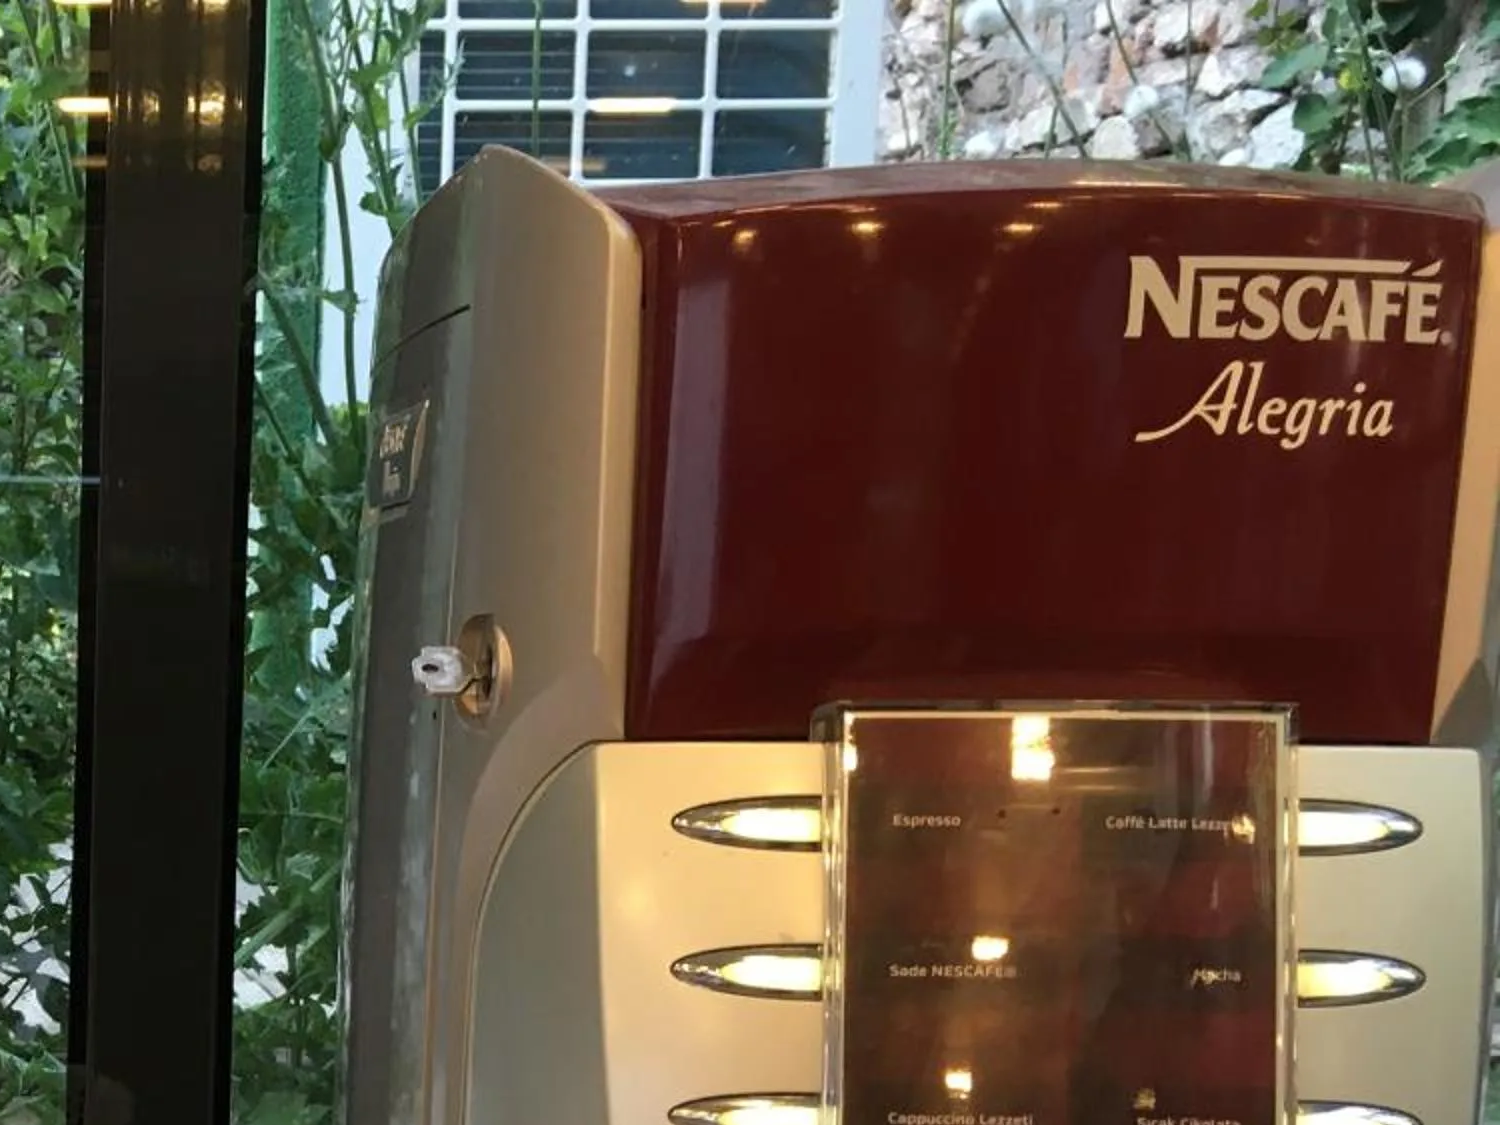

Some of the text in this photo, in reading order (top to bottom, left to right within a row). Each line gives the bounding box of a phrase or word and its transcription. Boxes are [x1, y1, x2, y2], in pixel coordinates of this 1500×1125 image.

[1135, 360, 1393, 450] Alegria
[892, 813, 961, 828] Espresso
[1150, 817, 1187, 829] Latte
[888, 964, 927, 977] Sade
[887, 1112, 974, 1125] Cappuccino
